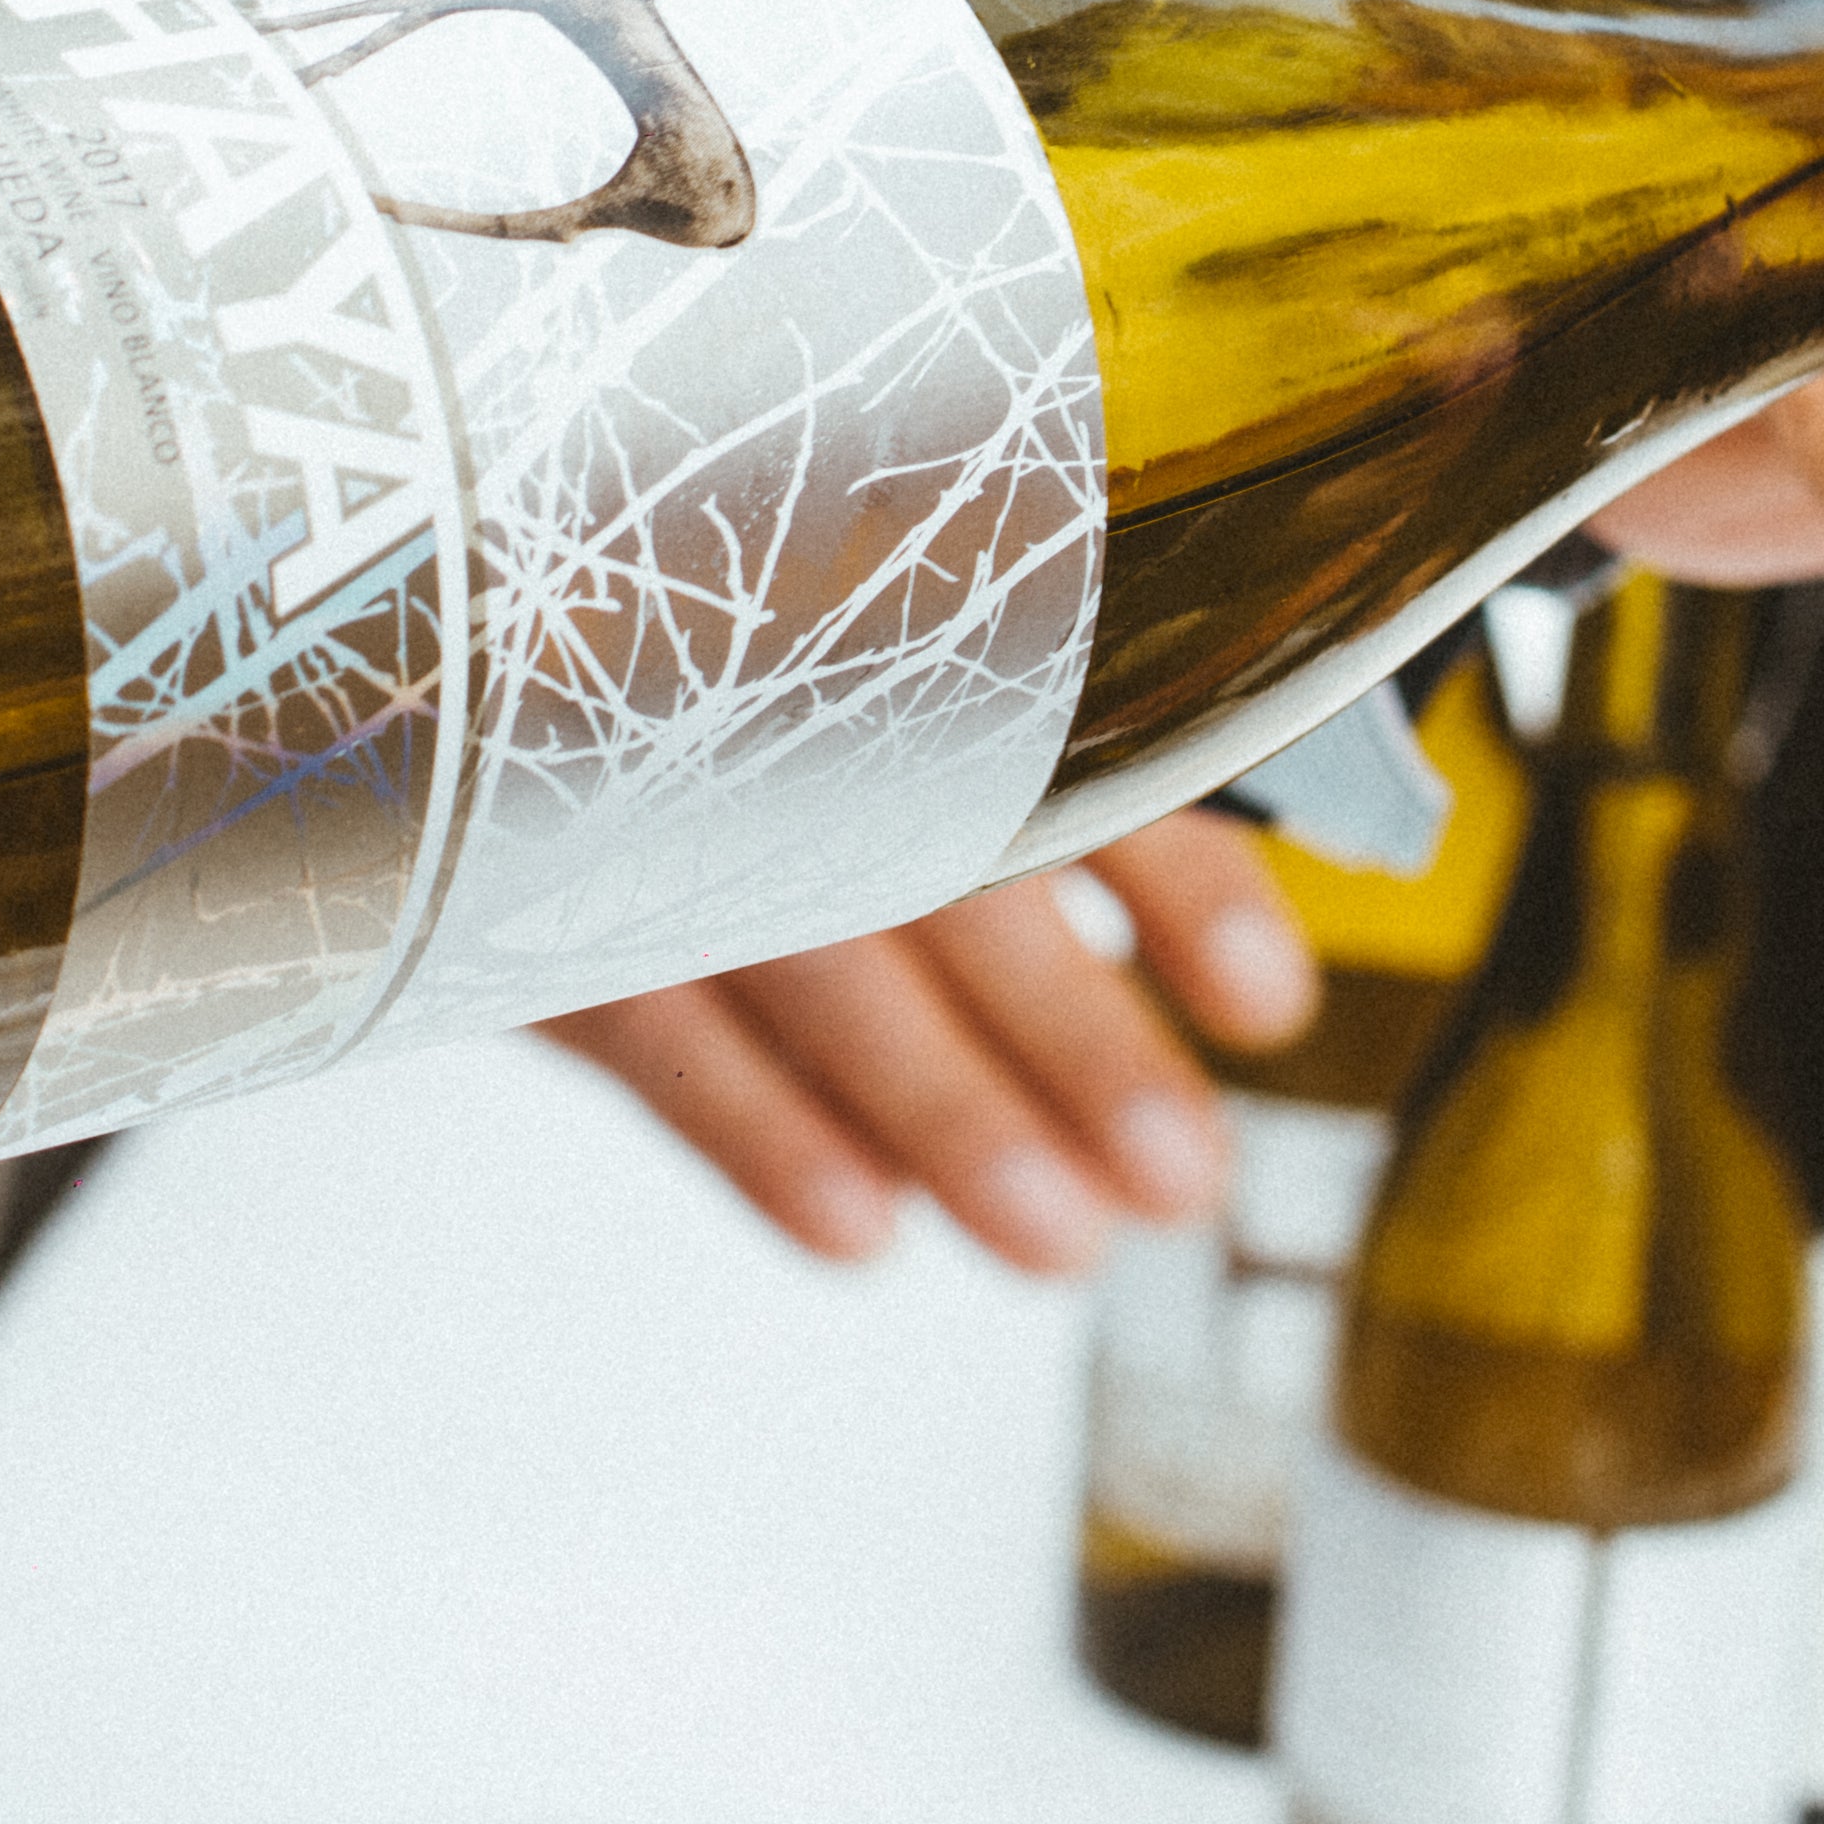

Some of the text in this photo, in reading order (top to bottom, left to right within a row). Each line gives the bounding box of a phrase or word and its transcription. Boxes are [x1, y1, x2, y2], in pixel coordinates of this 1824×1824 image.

[65, 127, 148, 208] 2017
[38, 155, 98, 222] WINE
[91, 249, 140, 323] VINO
[120, 333, 179, 464] BLANCO
